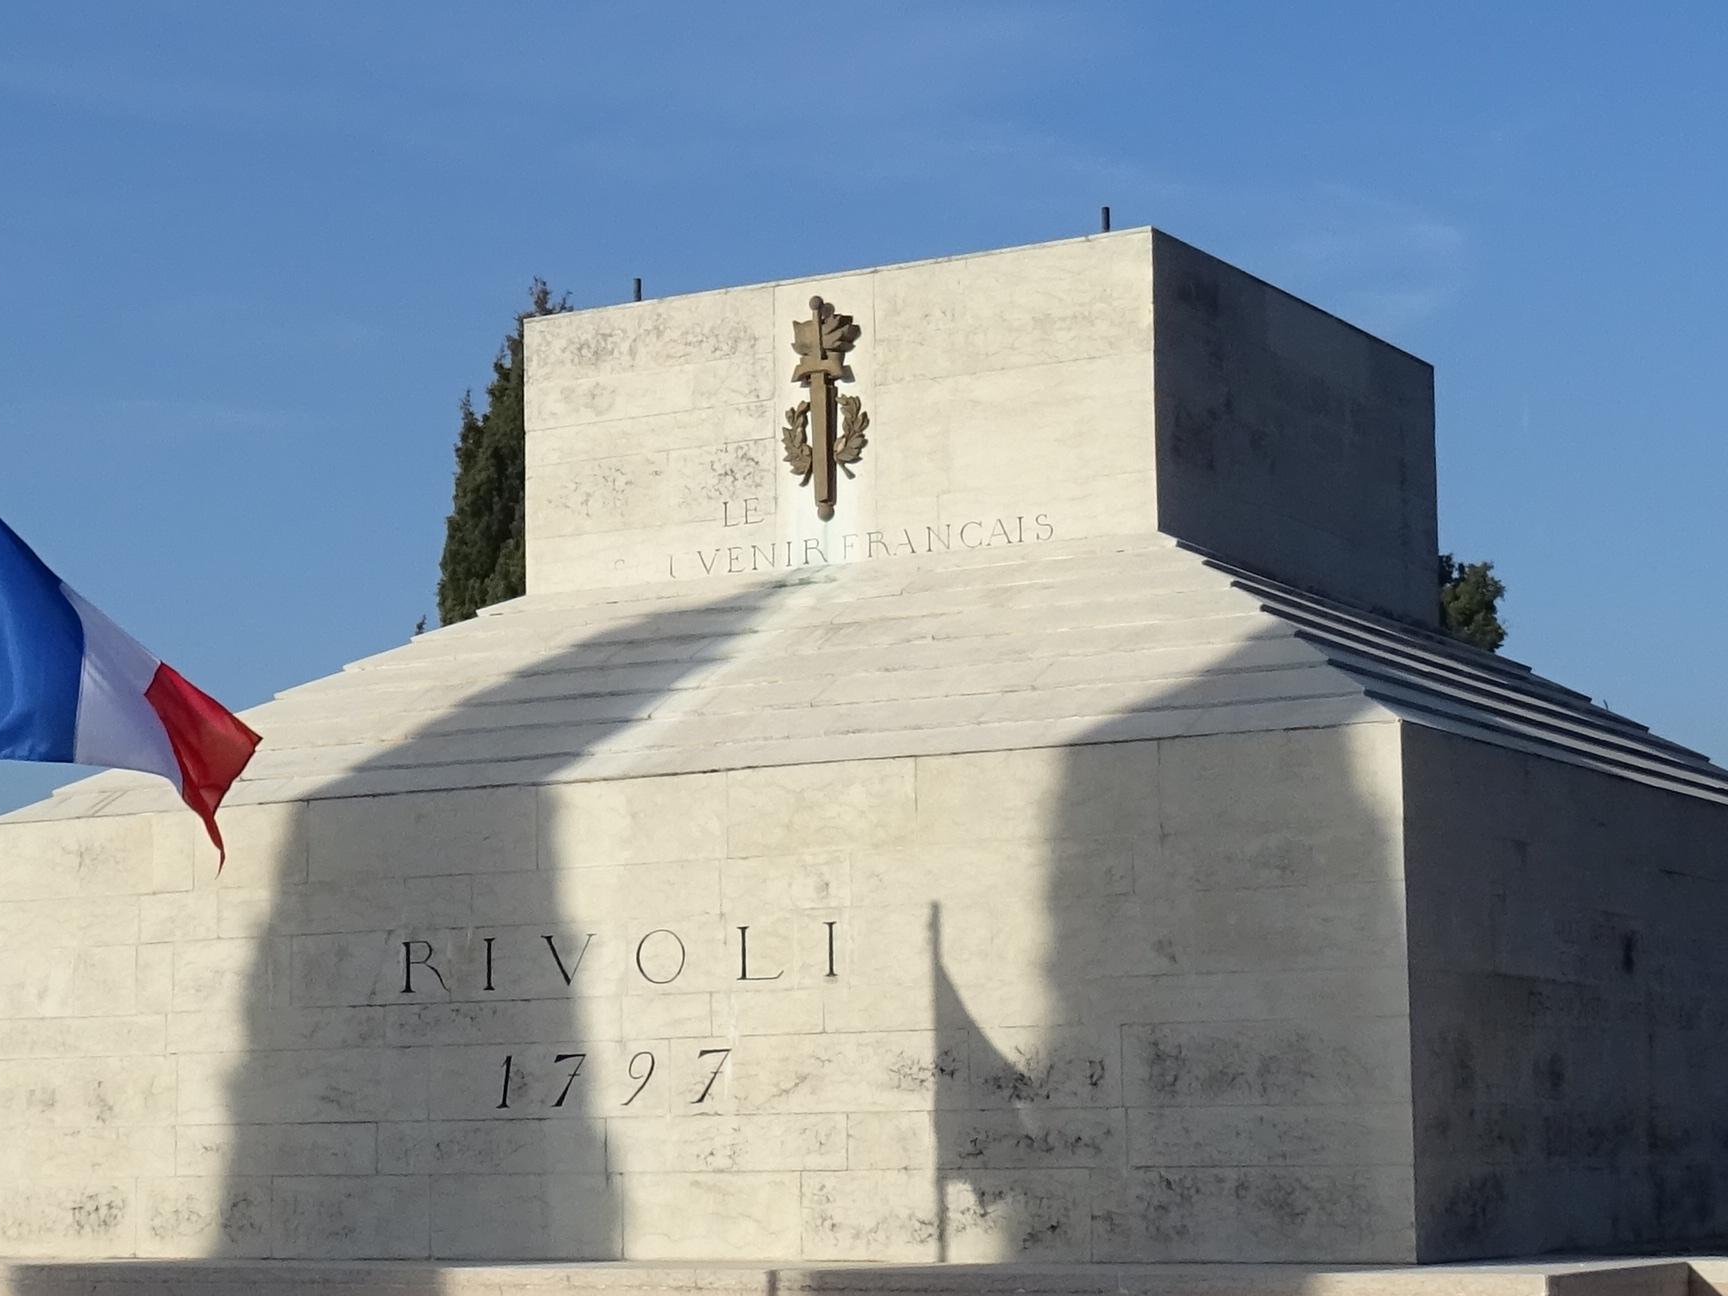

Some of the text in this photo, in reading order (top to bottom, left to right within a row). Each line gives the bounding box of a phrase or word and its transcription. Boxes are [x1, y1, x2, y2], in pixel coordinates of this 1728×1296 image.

[721, 496, 766, 528] LE
[614, 537, 829, 579] VENIR
[398, 920, 838, 995] RIVOLI
[495, 1048, 732, 1110] 1797
